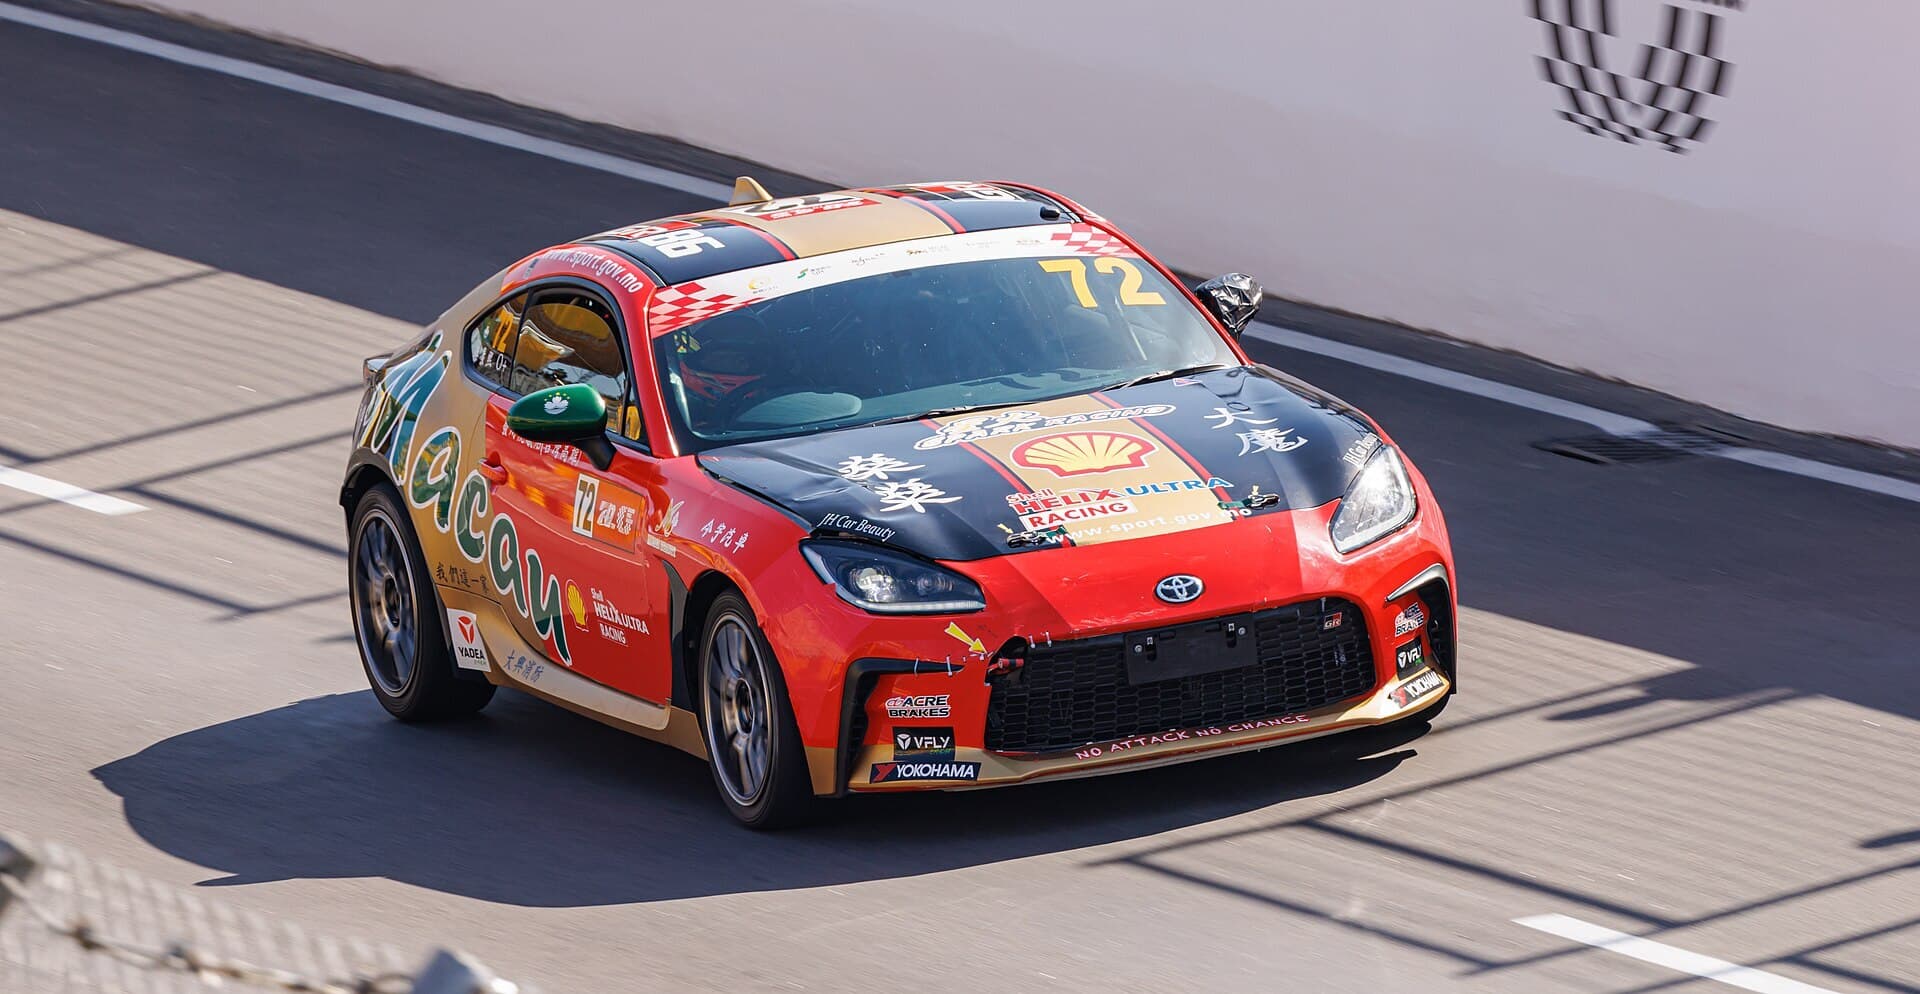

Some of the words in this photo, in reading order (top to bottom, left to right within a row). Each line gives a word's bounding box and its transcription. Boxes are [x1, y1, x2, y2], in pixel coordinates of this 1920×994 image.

[543, 250, 644, 293] www.sport.gov.mo
[1037, 257, 1167, 308] 72
[1043, 406, 1165, 427] RACING
[574, 479, 596, 532] 72
[1006, 489, 1054, 501] Shell
[1013, 488, 1121, 514] HELIX
[1124, 478, 1234, 497] ULTRA
[1028, 502, 1128, 527] RACING
[816, 512, 840, 528] JH
[836, 515, 858, 529] Car
[855, 519, 896, 542] Beauty
[593, 600, 623, 626] HELIX
[621, 613, 650, 635] ULTRA
[600, 623, 626, 644] RACING
[458, 646, 485, 660] YADEA
[889, 707, 950, 717] BRAKES
[901, 695, 950, 707] ACRE
[913, 736, 950, 749] VFLY
[1075, 746, 1102, 760] NO
[1110, 730, 1190, 753] ATTACK
[1195, 726, 1222, 738] NO
[1228, 715, 1311, 733] CHANCE
[896, 763, 975, 778] YOKOHAMA
